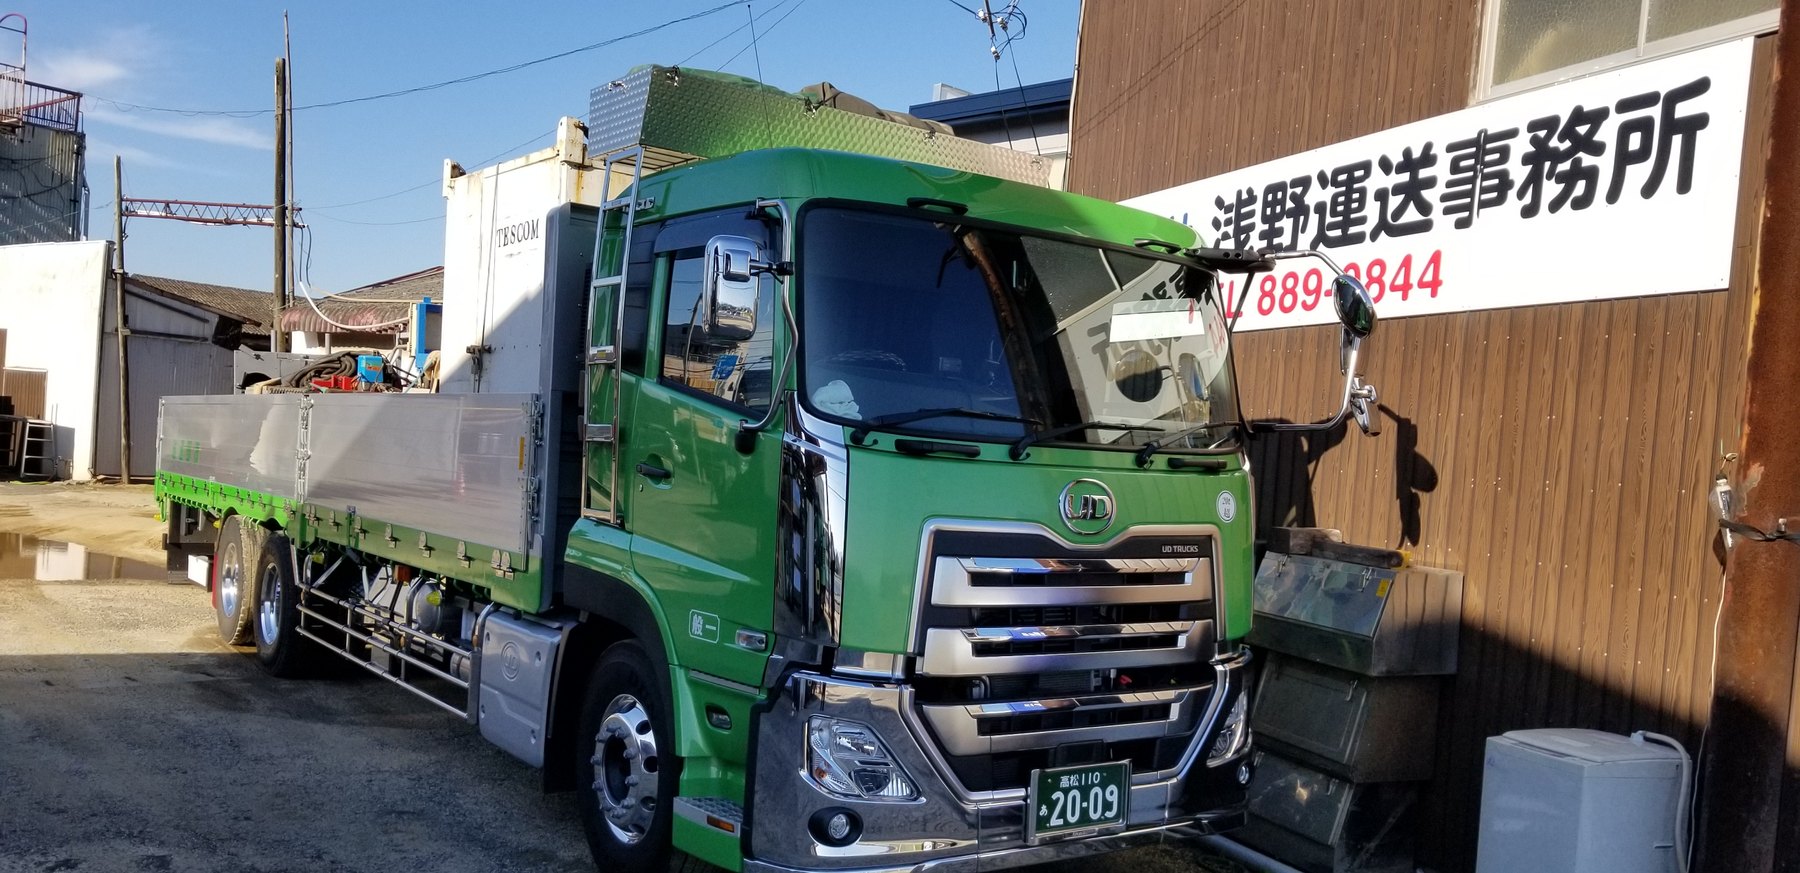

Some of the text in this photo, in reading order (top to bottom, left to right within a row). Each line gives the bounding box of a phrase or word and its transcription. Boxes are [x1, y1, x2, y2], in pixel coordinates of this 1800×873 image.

[1212, 76, 1711, 253] 浅野運送事務所
[497, 218, 539, 247] TESCOM
[1065, 494, 1113, 520] UD
[1161, 545, 1199, 553] UD TRUCKS
[1039, 784, 1119, 827] あ 20-09
